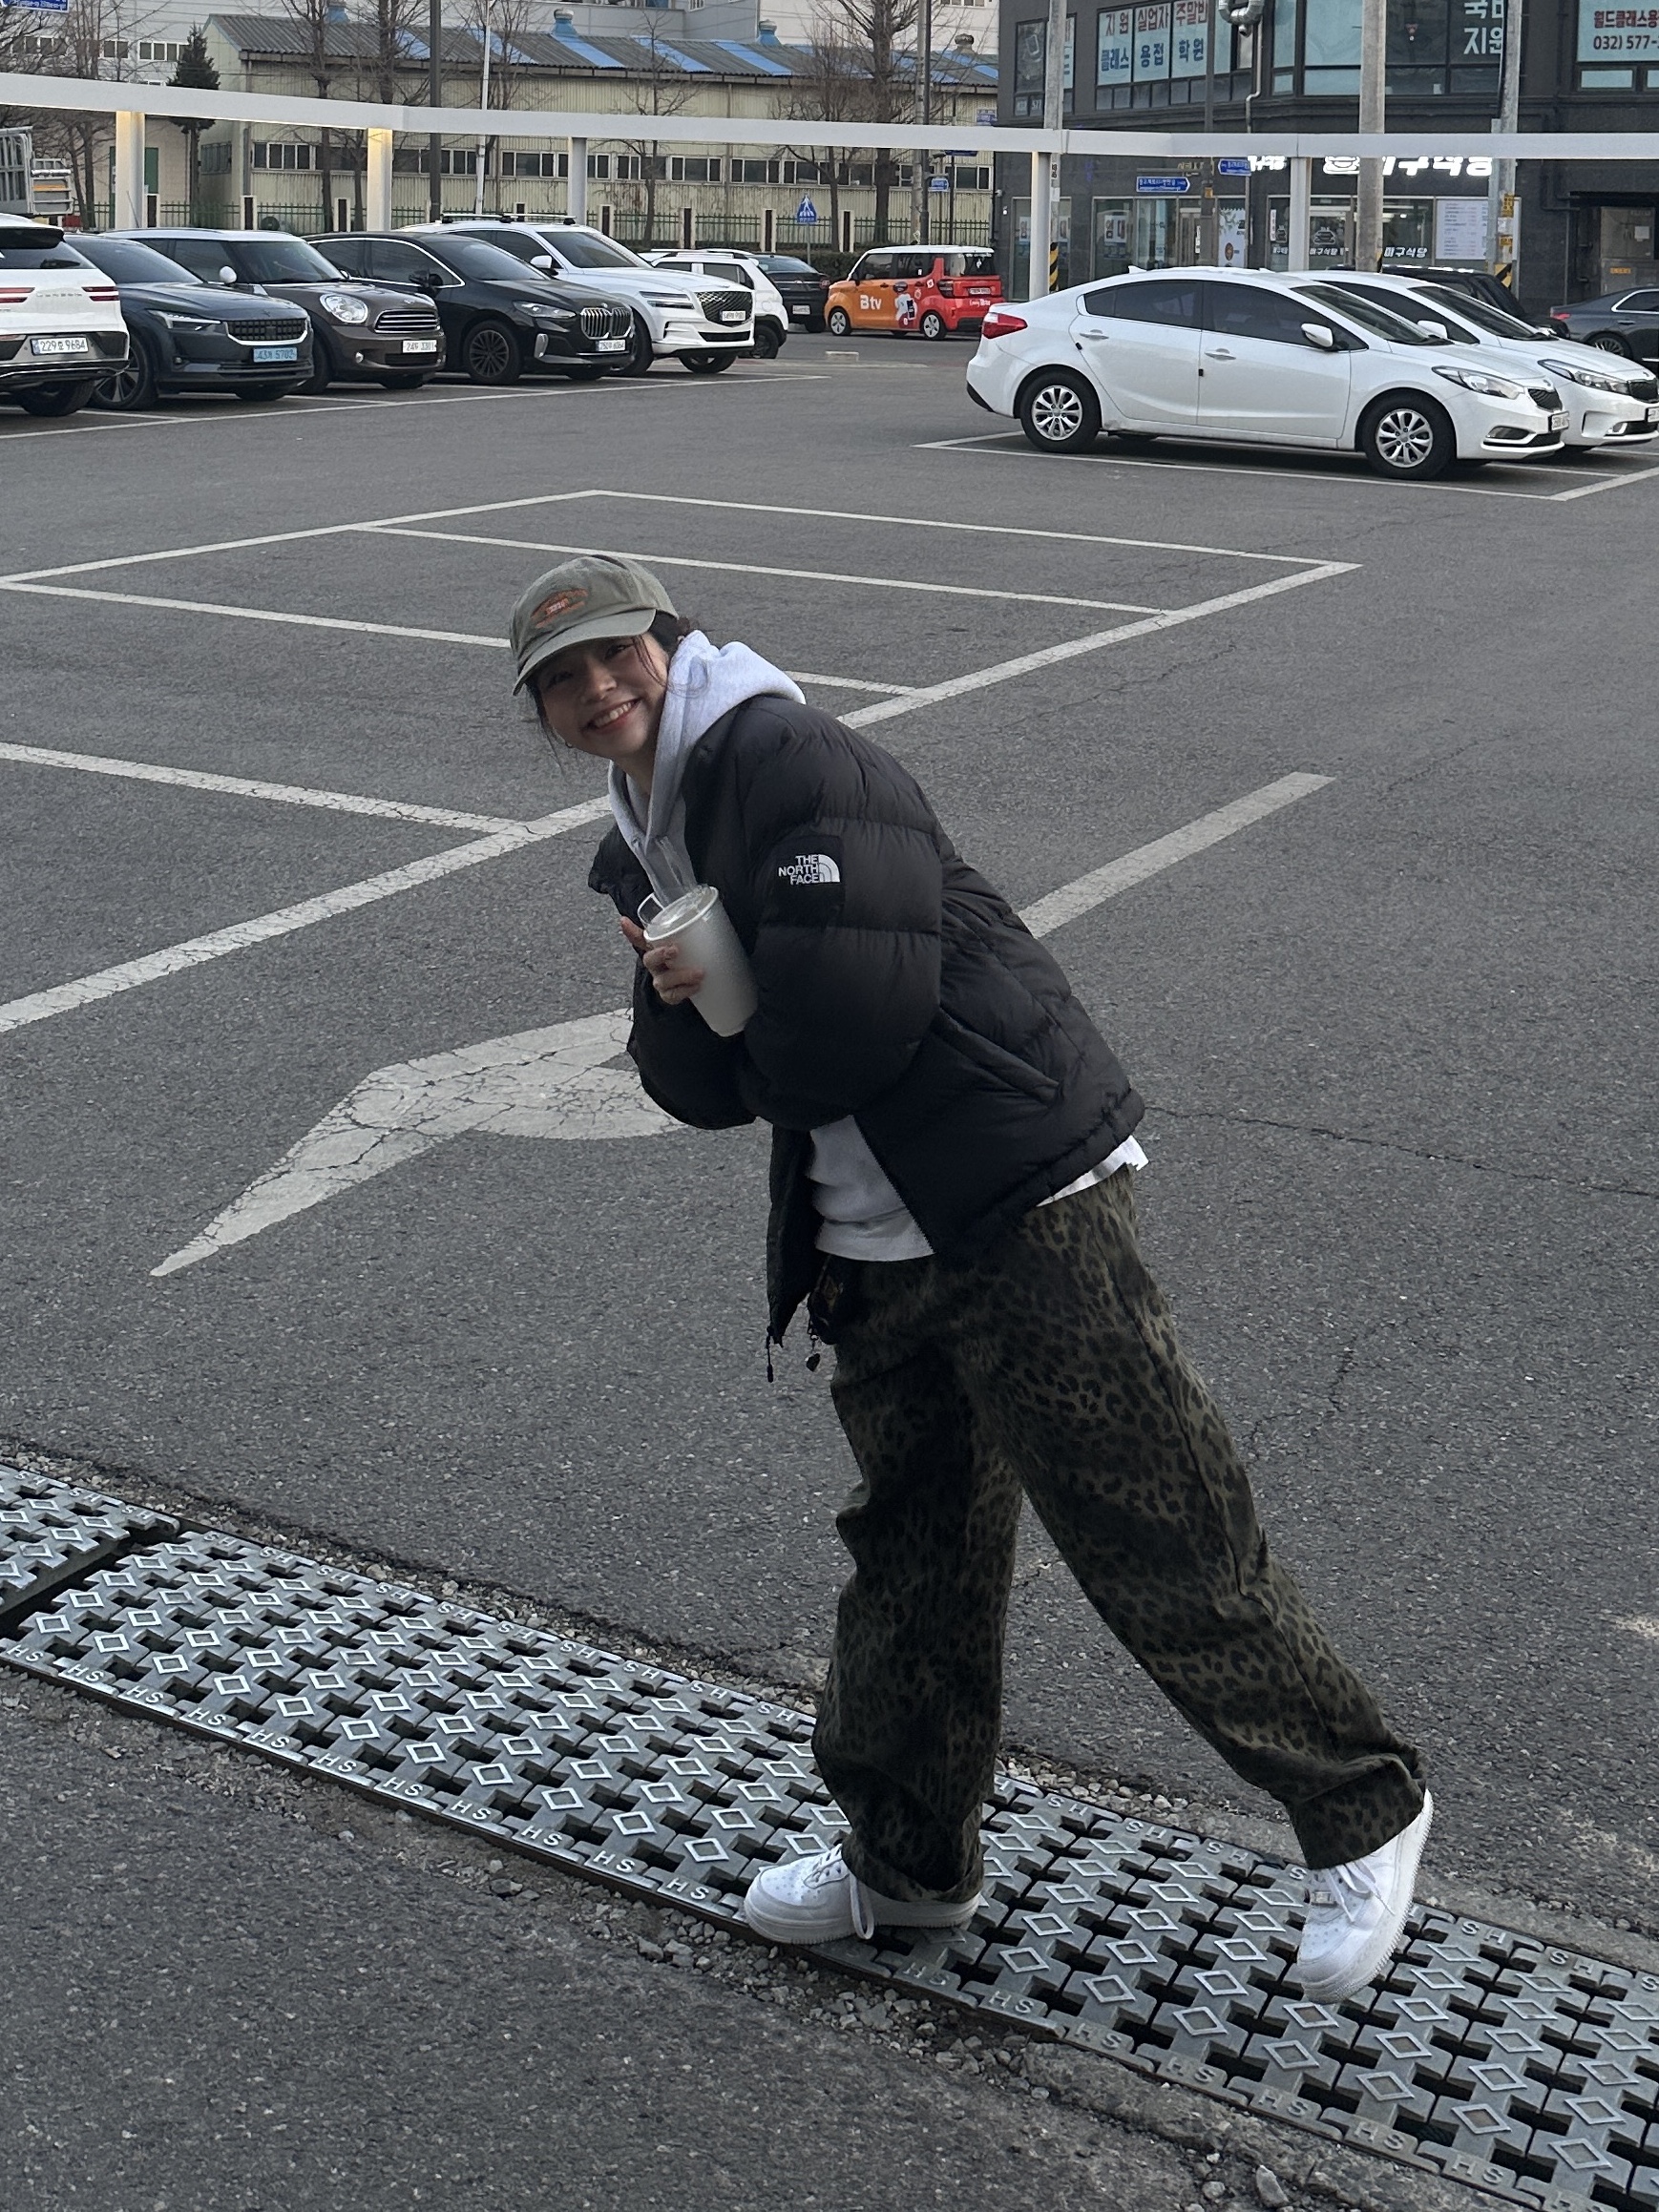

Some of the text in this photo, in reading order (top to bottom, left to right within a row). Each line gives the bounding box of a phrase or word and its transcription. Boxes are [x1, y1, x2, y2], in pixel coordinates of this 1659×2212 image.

[1137, 6, 1169, 32] 실업자
[1594, 10, 1659, 29] 월드클래스용
[1593, 34, 1659, 51] 032) 577-
[1101, 47, 1129, 72] 클래스
[1141, 43, 1164, 68] 용접
[1179, 38, 1204, 63] 학원
[795, 854, 819, 865] THE
[778, 863, 819, 877] NORTH
[790, 873, 819, 885] FACE
[7, 1644, 43, 1662] HS
[67, 1663, 104, 1682] HS
[127, 1685, 164, 1704] HS
[188, 1707, 226, 1726] HS
[251, 1729, 290, 1748] HS
[317, 1752, 357, 1773] HS
[383, 1777, 424, 1797] HS
[451, 1800, 492, 1821] HS
[521, 1825, 563, 1847] HS
[593, 1850, 635, 1874] HS
[666, 1877, 709, 1901] HS
